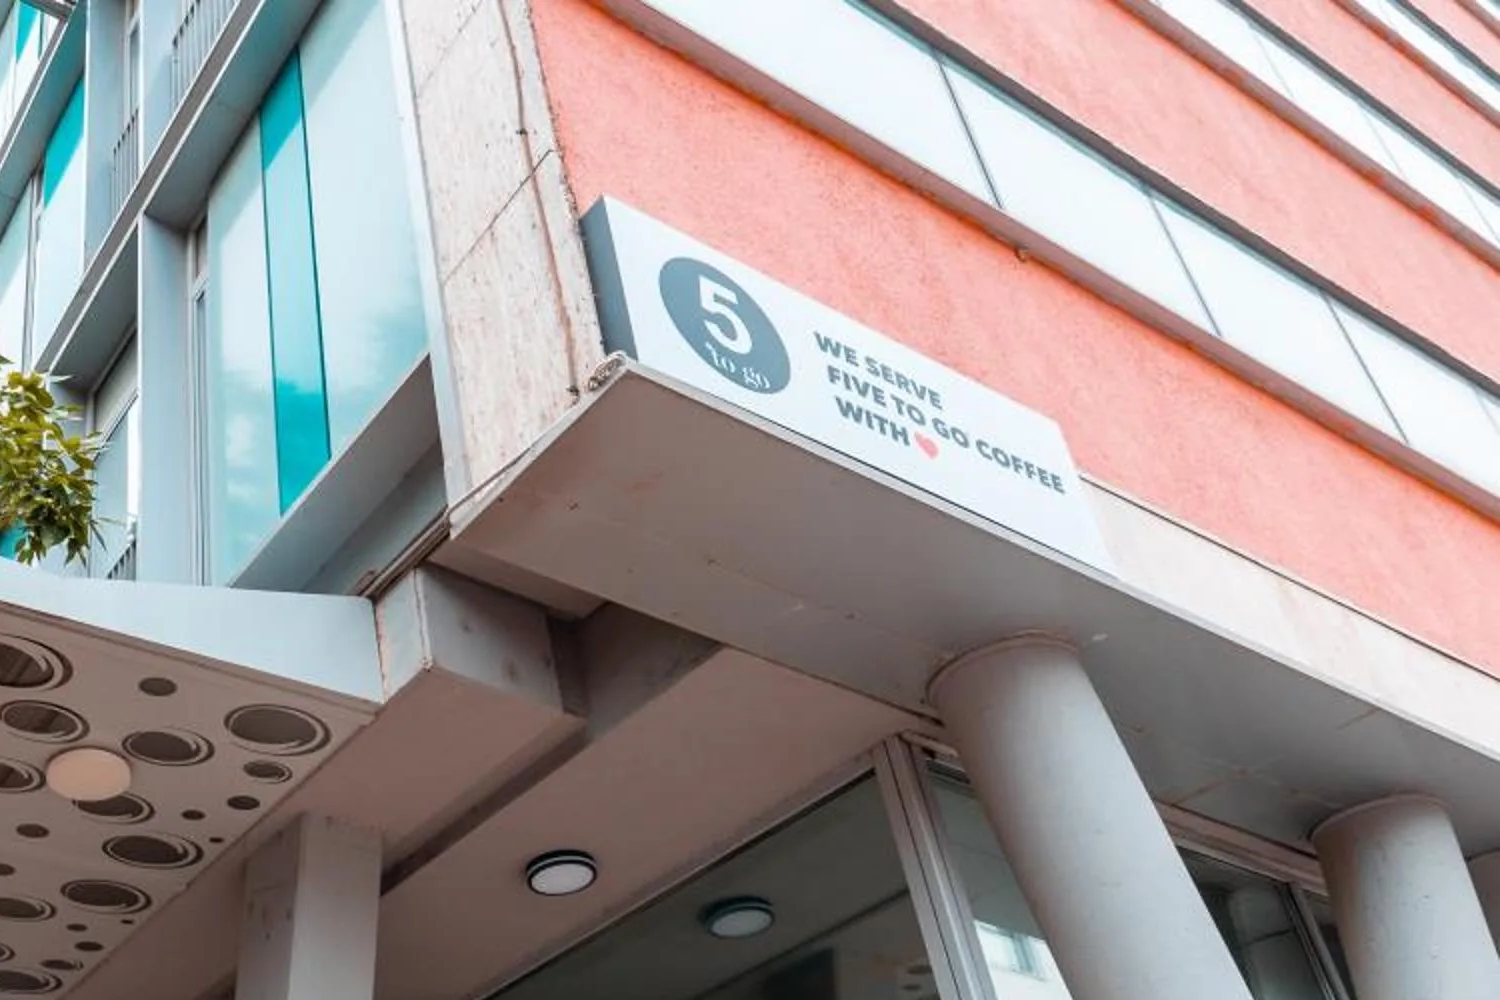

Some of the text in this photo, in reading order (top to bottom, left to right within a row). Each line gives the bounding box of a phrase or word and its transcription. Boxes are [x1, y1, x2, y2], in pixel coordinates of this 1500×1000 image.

[698, 275, 753, 354] 5
[813, 331, 943, 410] WE SERVE
[827, 365, 1067, 495] FIVE TO GO COFFEE
[835, 396, 911, 447] WITH
